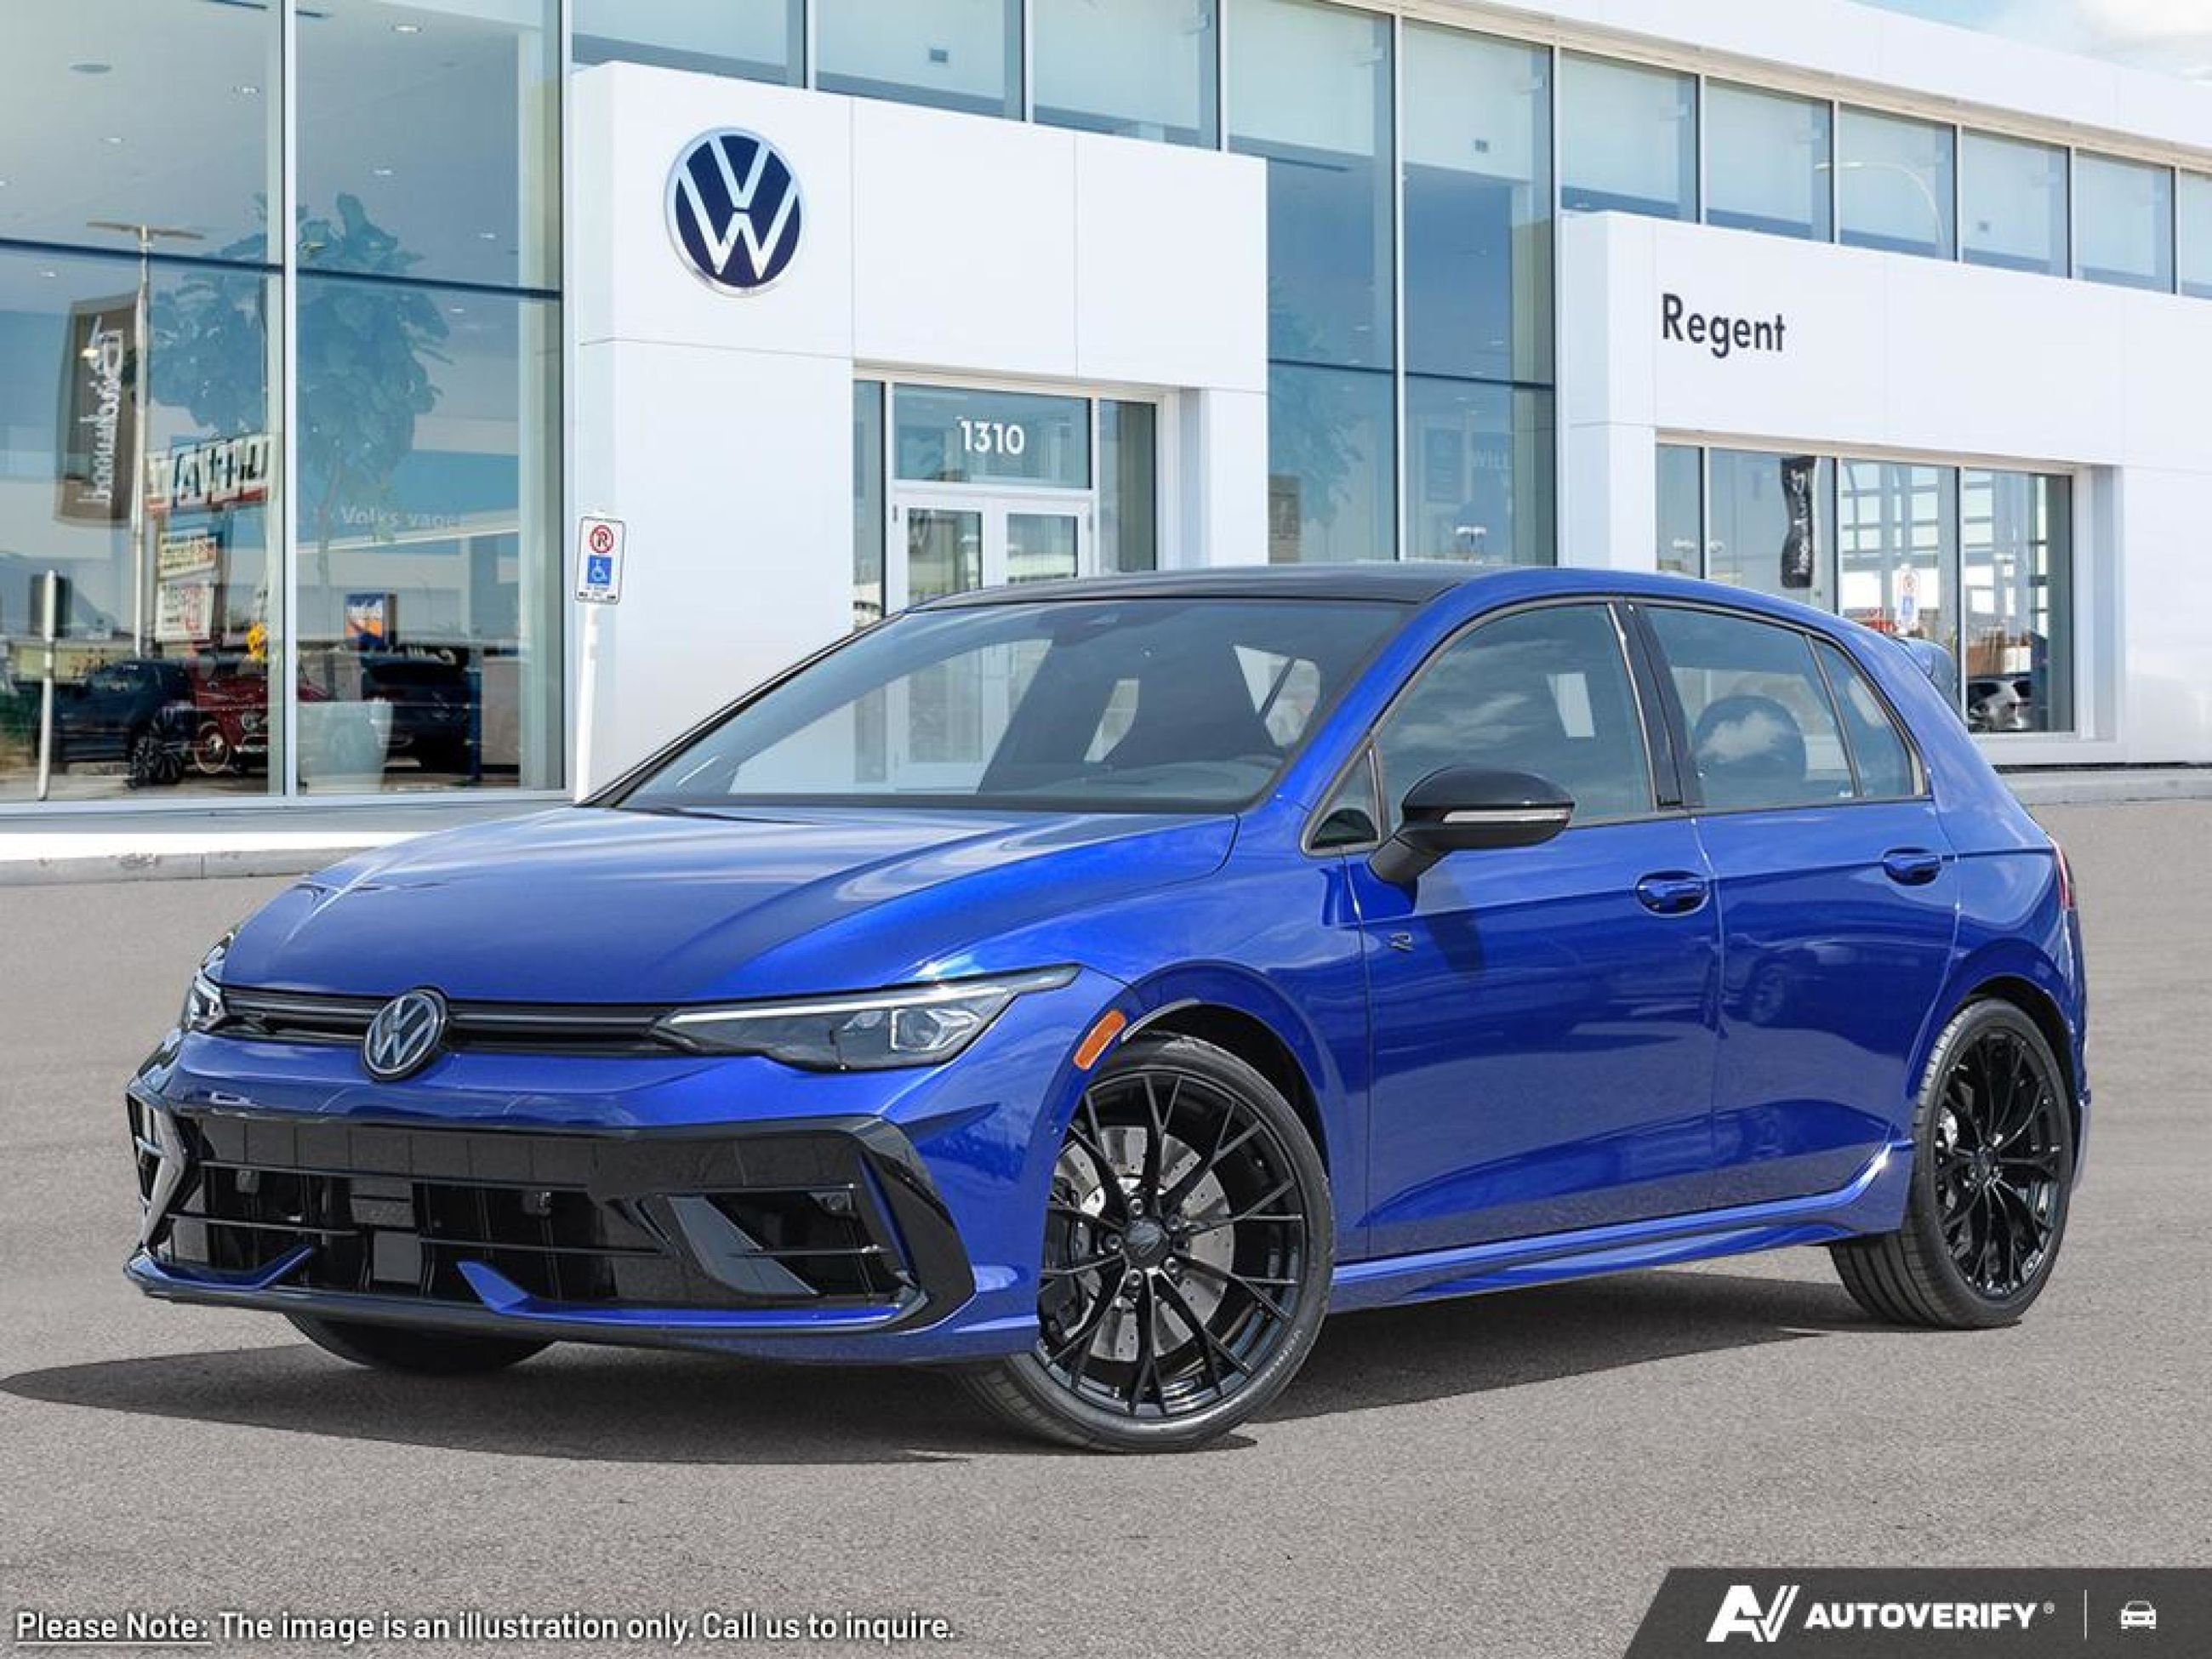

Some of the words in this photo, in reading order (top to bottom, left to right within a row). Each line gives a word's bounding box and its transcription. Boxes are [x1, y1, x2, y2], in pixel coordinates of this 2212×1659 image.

[669, 129, 803, 288] VW
[1662, 292, 1785, 359] Regent
[960, 419, 1025, 455] 1310
